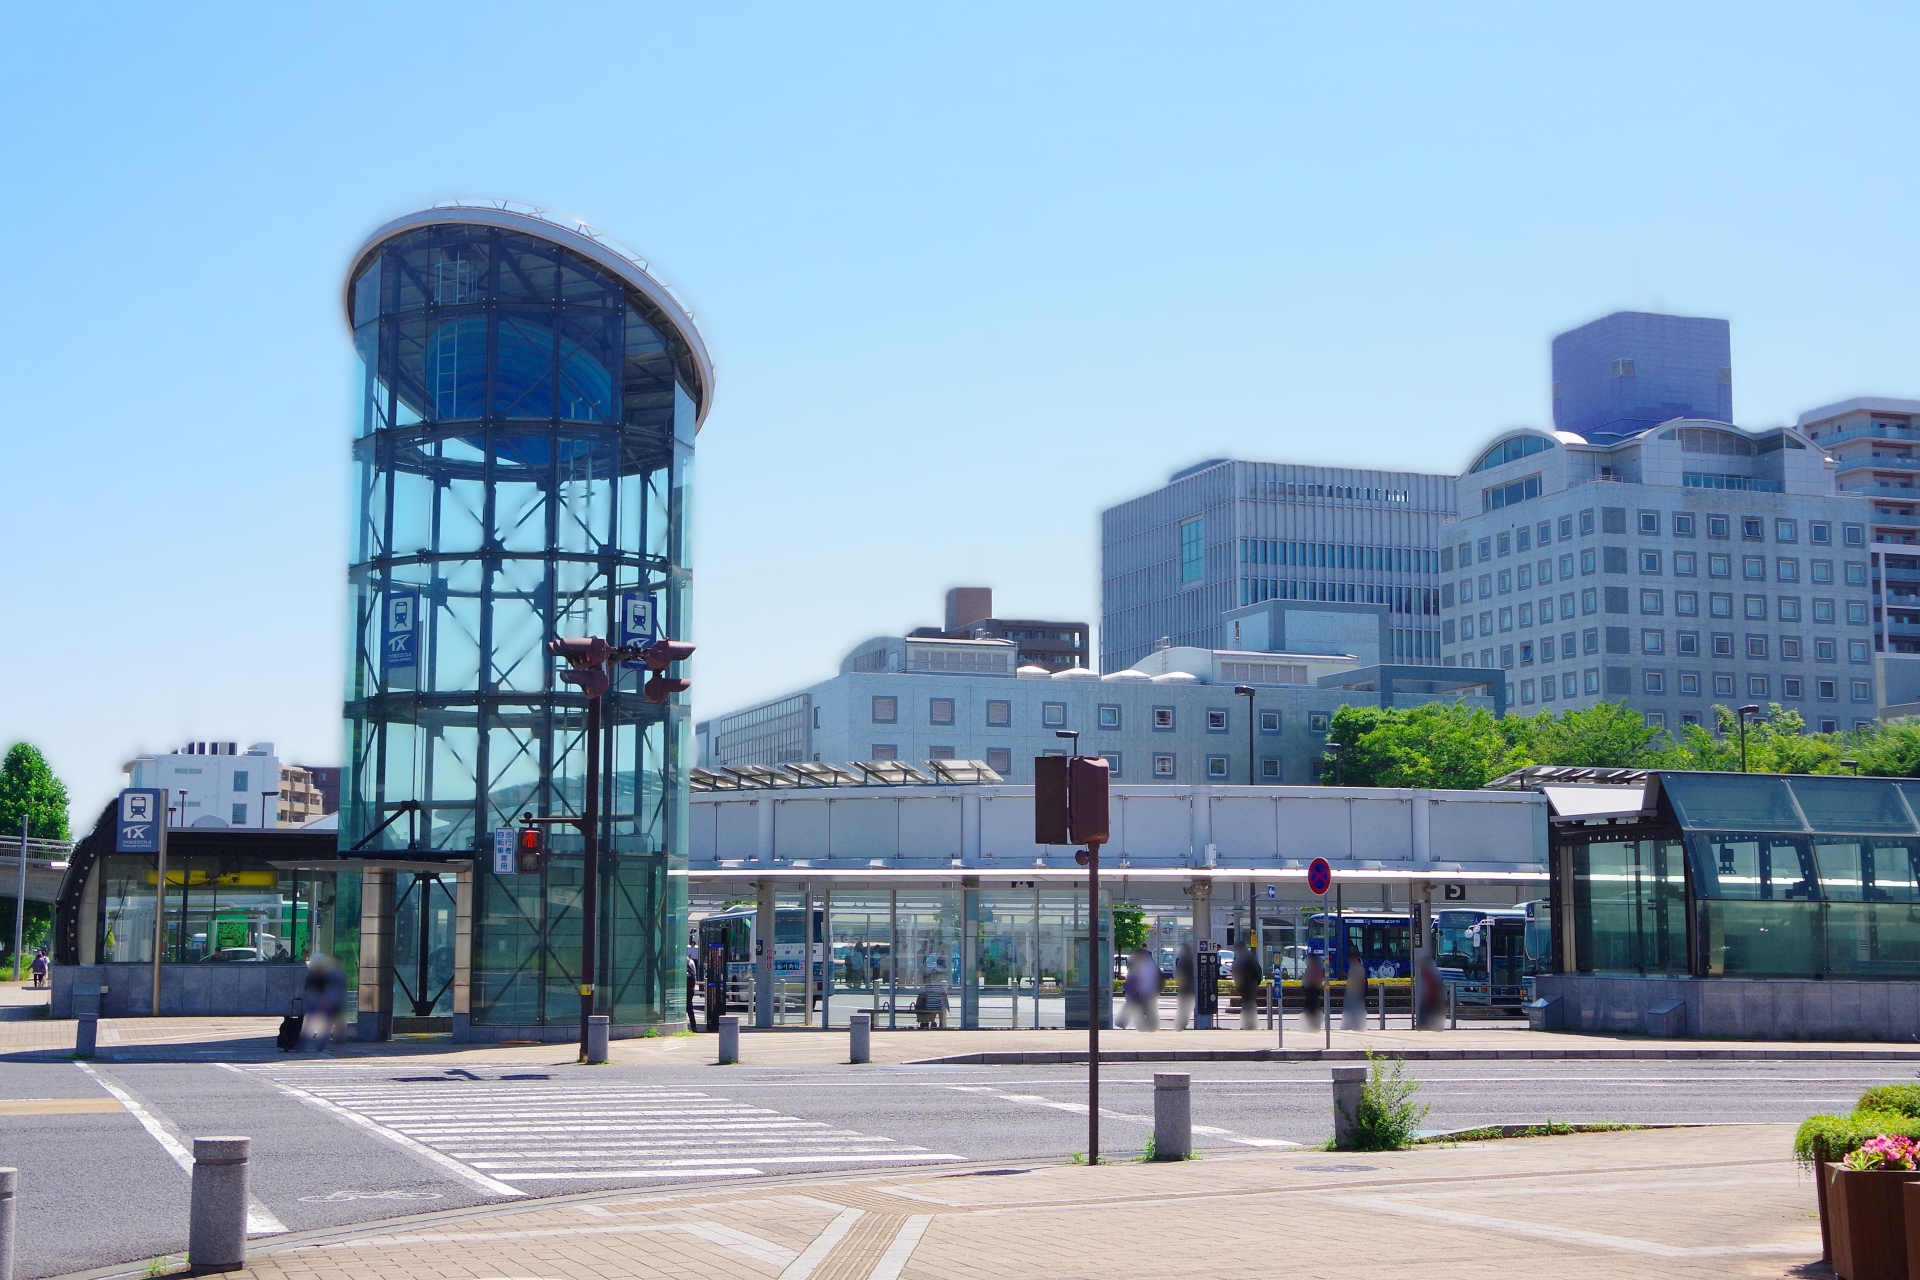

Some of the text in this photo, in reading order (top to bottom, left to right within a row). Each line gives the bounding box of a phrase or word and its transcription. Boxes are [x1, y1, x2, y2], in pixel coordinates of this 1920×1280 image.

[388, 634, 411, 651] TX
[123, 825, 151, 839] TX
[1209, 943, 1216, 951] 1F
